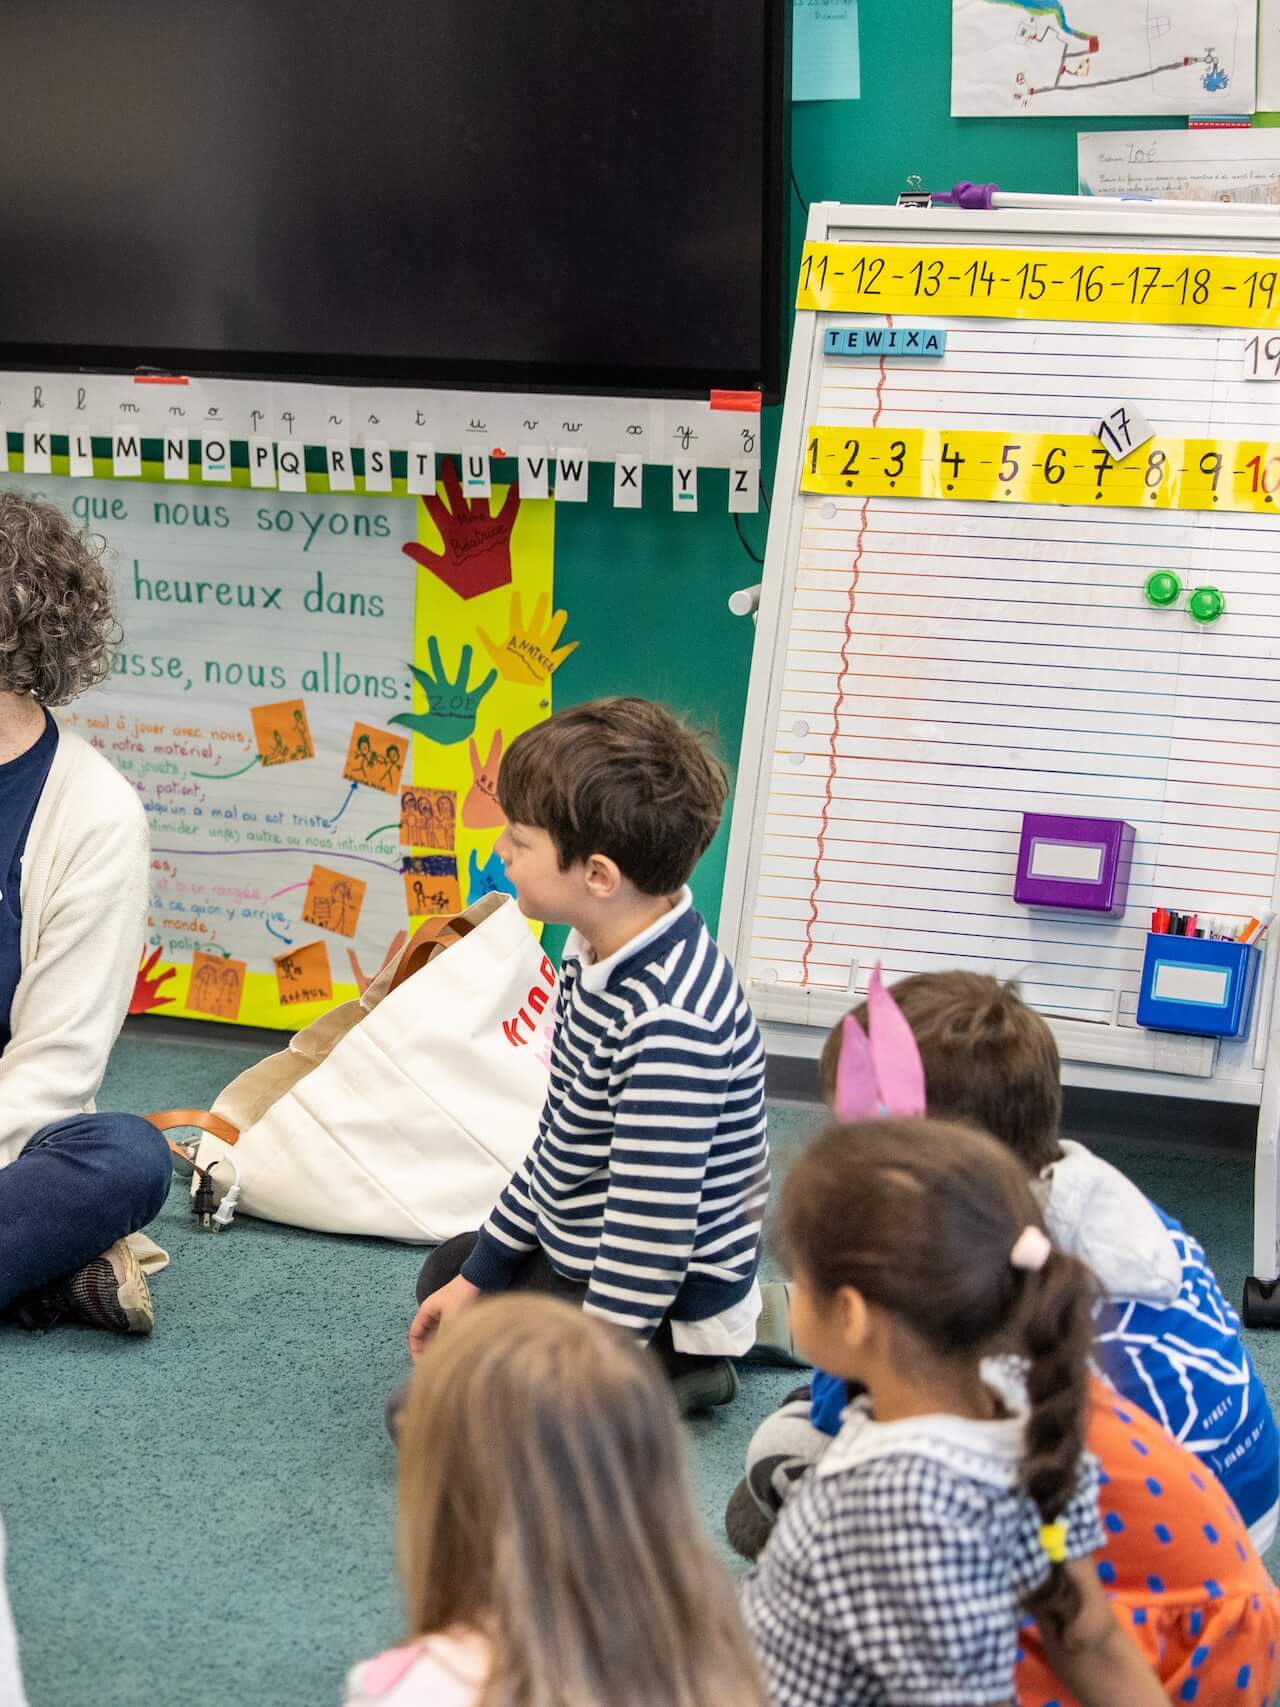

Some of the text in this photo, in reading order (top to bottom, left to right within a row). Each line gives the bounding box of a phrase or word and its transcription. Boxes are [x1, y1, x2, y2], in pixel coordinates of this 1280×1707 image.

[801, 254, 1278, 310] 11 12 13 14 15 16 17 18 19
[830, 330, 939, 350] TEWIXA
[1245, 335, 1280, 376] 19
[32, 386, 46, 409] k
[76, 388, 87, 411] l
[120, 402, 140, 414] m
[169, 404, 187, 416] n
[207, 407, 220, 417] o
[250, 409, 265, 433] p
[281, 411, 295, 434] q
[328, 415, 343, 426] r
[368, 414, 381, 425] s
[415, 410, 427, 427] t
[470, 418, 487, 430] u
[523, 420, 540, 431] v
[562, 421, 584, 433] w
[626, 424, 644, 436] x
[677, 425, 694, 450] y
[740, 428, 756, 453] z
[1097, 407, 1131, 454] 17
[34, 434, 47, 454] K
[77, 437, 87, 457] L
[117, 436, 138, 457] M
[168, 440, 184, 460] N
[206, 441, 226, 462] O
[257, 448, 268, 468] P
[280, 451, 300, 475] Q
[332, 450, 345, 472] R
[372, 451, 384, 473] S
[416, 454, 428, 476] T
[469, 456, 483, 478] U
[527, 457, 545, 479] V
[560, 459, 584, 482] W
[621, 466, 638, 488] X
[678, 469, 692, 491] Y
[735, 469, 748, 492] Z
[808, 438, 1280, 493] 1 2 3 4 5 6 7 8 9 10
[72, 495, 392, 551] que nous soyons
[133, 560, 385, 617] heureux dans
[109, 650, 412, 701] asse, nous allons:
[87, 717, 110, 729] seul
[116, 716, 126, 730] à
[133, 719, 166, 738] jouer
[172, 724, 202, 738] avec
[90, 736, 105, 749] de
[112, 737, 145, 753] notre
[148, 820, 200, 835] ntimider
[247, 831, 283, 845] autre
[287, 836, 301, 845] ou
[306, 837, 333, 850] nous
[194, 807, 203, 816] a
[211, 805, 238, 819] mal
[243, 813, 257, 823] ou
[266, 812, 284, 824] est
[176, 879, 209, 893] bien
[171, 900, 186, 912] ce
[226, 907, 236, 920] y
[150, 934, 161, 946] et
